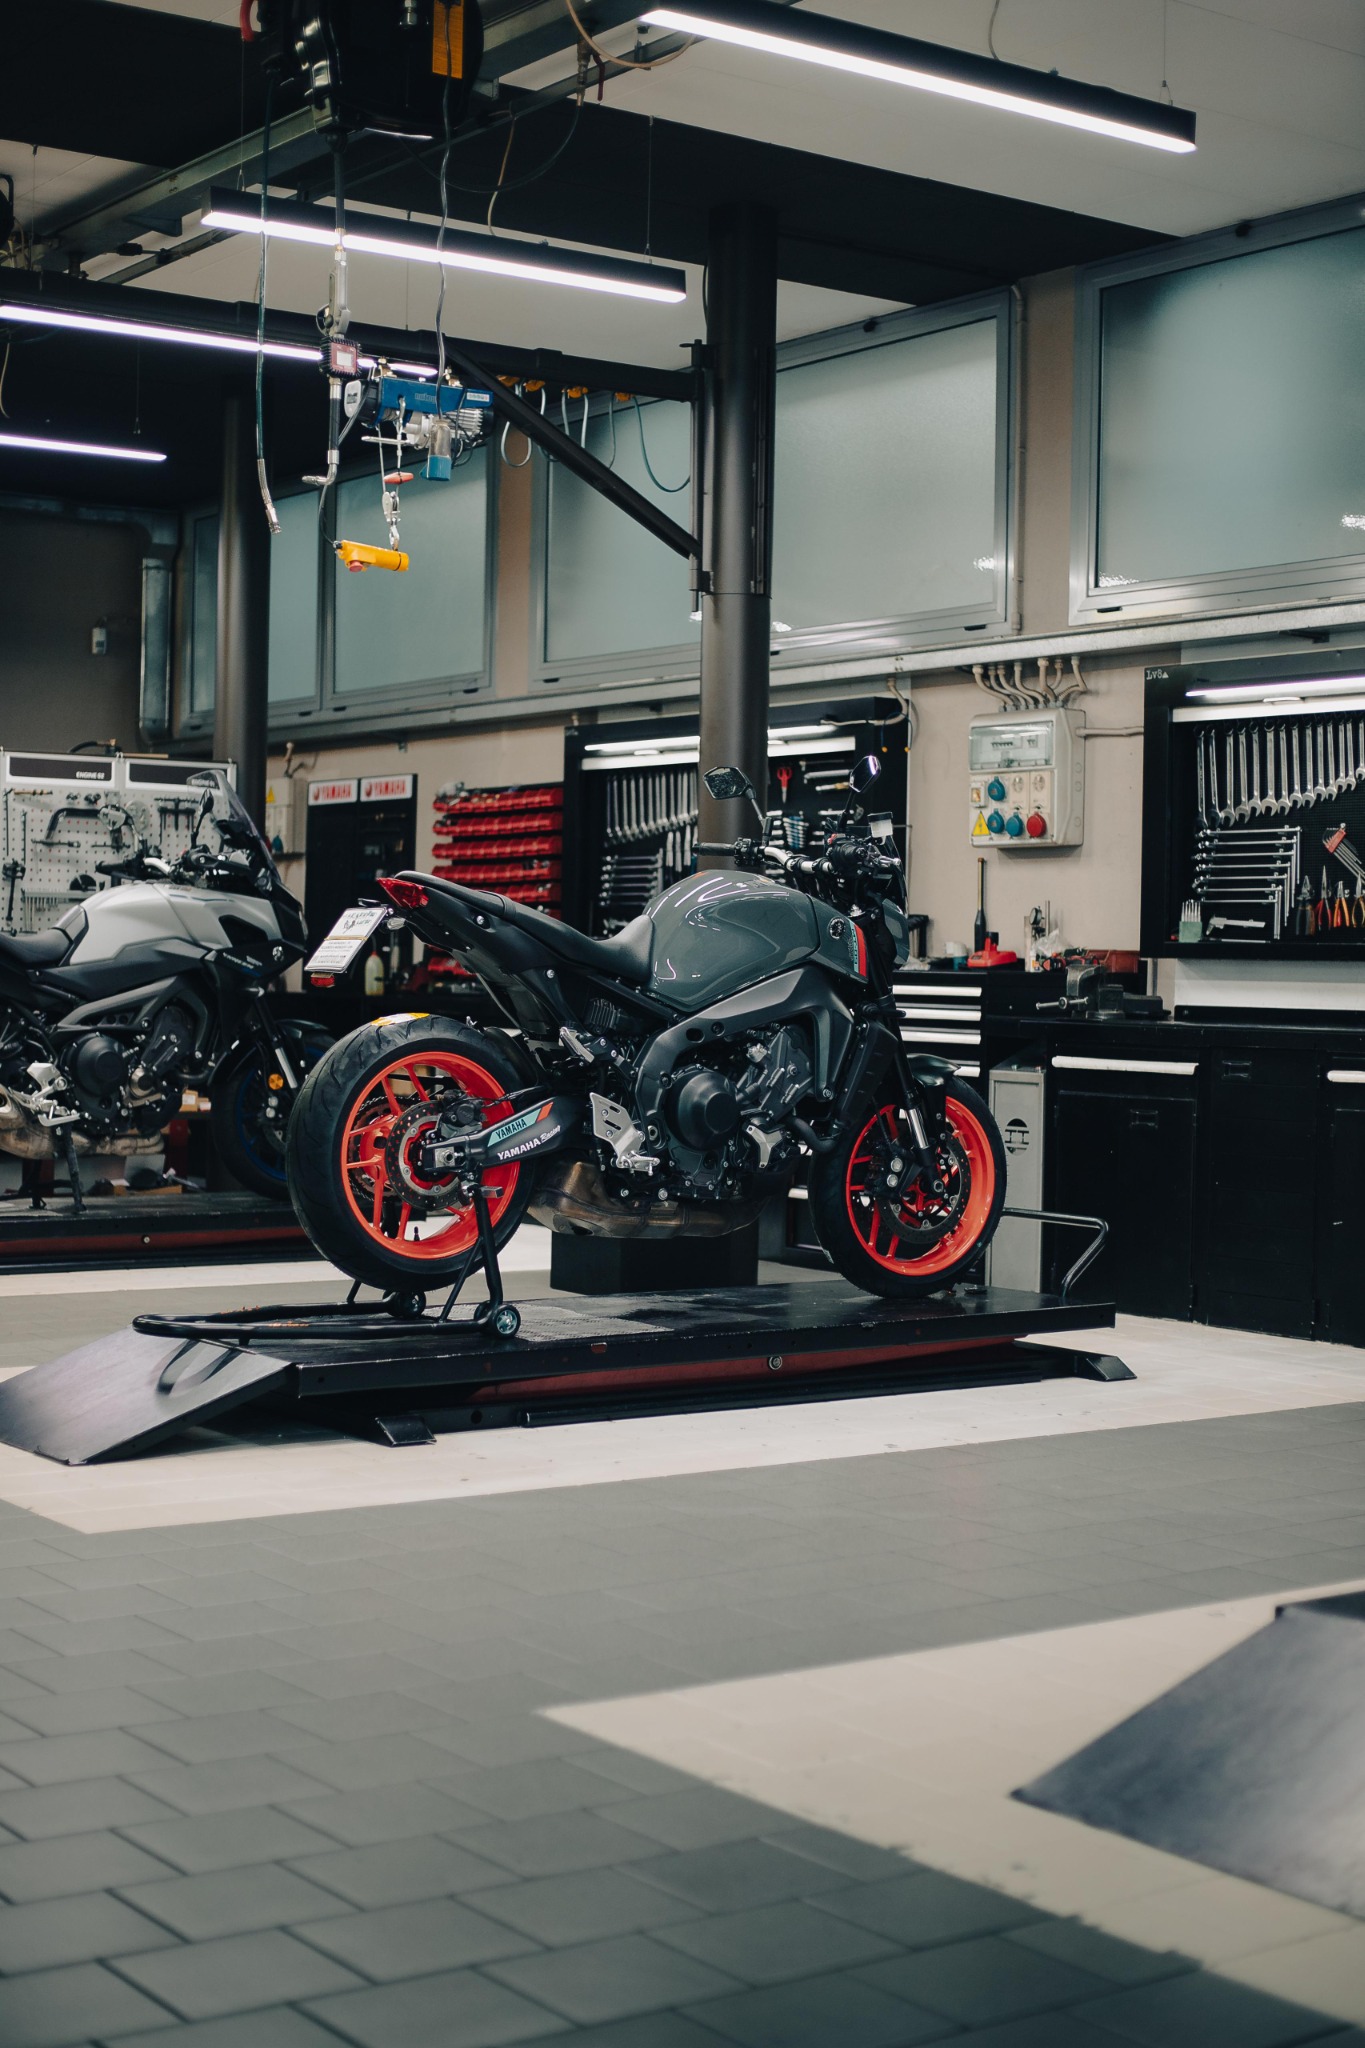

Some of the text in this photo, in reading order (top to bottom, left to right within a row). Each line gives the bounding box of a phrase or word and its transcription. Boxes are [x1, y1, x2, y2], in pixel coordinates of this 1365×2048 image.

[321, 784, 352, 800] YAMAHA
[374, 780, 406, 796] YAMAHA
[495, 1118, 528, 1140] YAMAHA
[497, 1137, 541, 1160] YAMAHA
